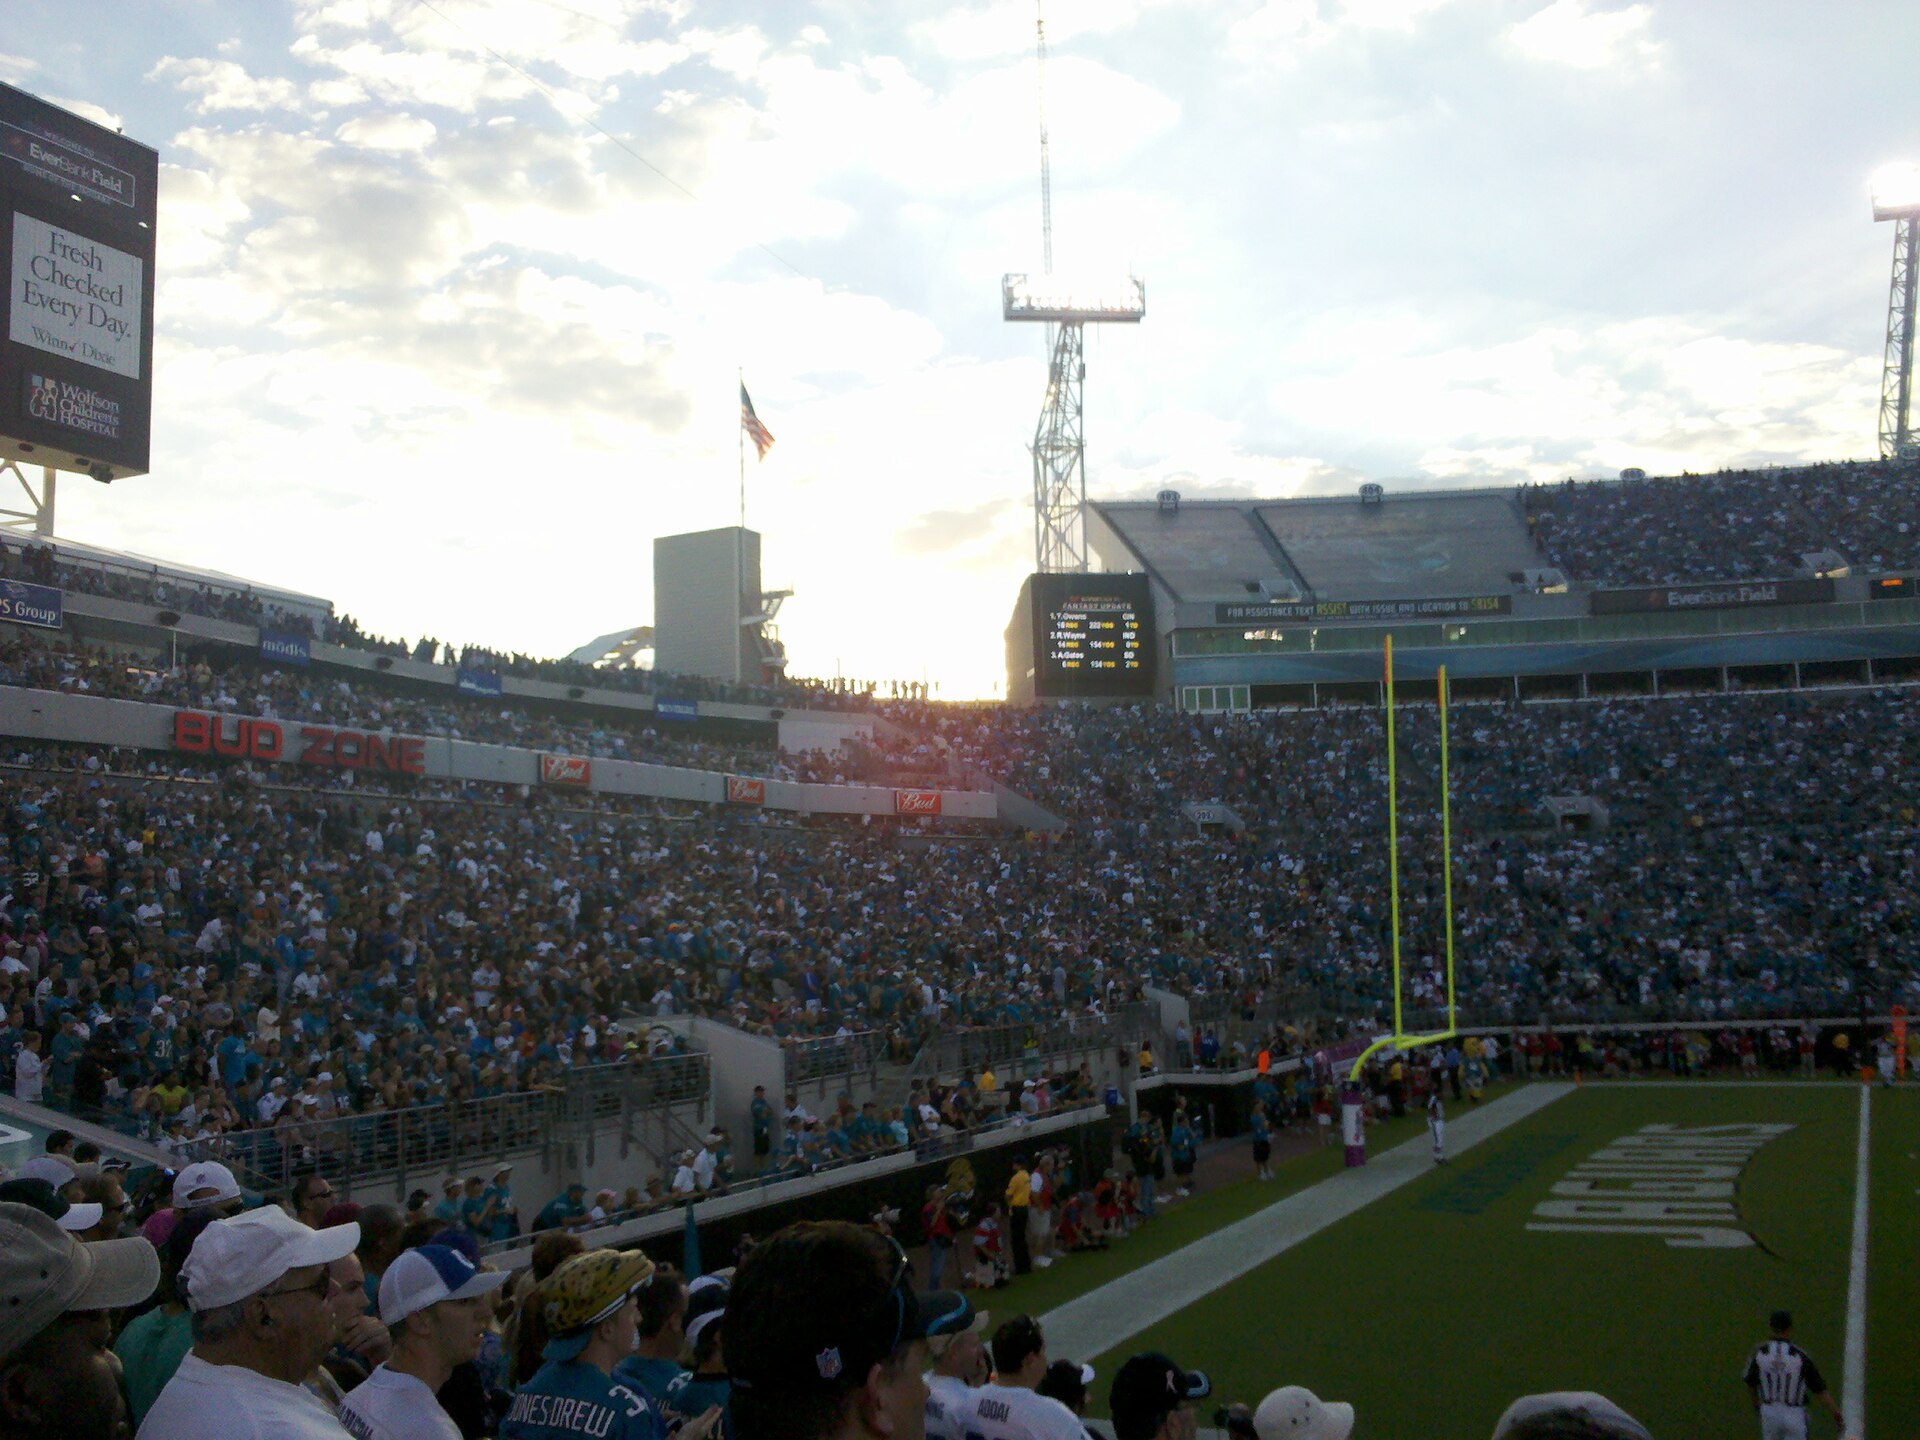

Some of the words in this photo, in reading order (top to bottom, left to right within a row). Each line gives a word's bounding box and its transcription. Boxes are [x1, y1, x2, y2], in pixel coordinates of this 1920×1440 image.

[30, 142, 90, 180] EverBank
[92, 168, 122, 194] Field
[50, 231, 103, 273] Fresh
[31, 255, 123, 307] Checked
[22, 279, 82, 327] Every
[88, 302, 131, 342] Day.
[31, 326, 68, 350] Winn
[82, 342, 117, 366] Dixie
[61, 382, 119, 413] Wolfson
[60, 411, 119, 438] HOSPITAL
[1738, 585, 1777, 602] Field
[15, 601, 56, 625] Group
[1245, 607, 1293, 617] ASSISTANCE
[1316, 602, 1347, 615] ASSIST
[1349, 605, 1370, 615] WITH
[1372, 604, 1396, 614] ISSUE
[1398, 603, 1415, 613] AND
[1417, 602, 1456, 612] LOCATION
[174, 710, 283, 760] BUD
[300, 726, 427, 774] ZONE
[547, 757, 586, 780] Bud
[732, 779, 762, 797] Bud
[901, 791, 937, 811] Bud
[976, 1398, 1011, 1424] ADDAI
